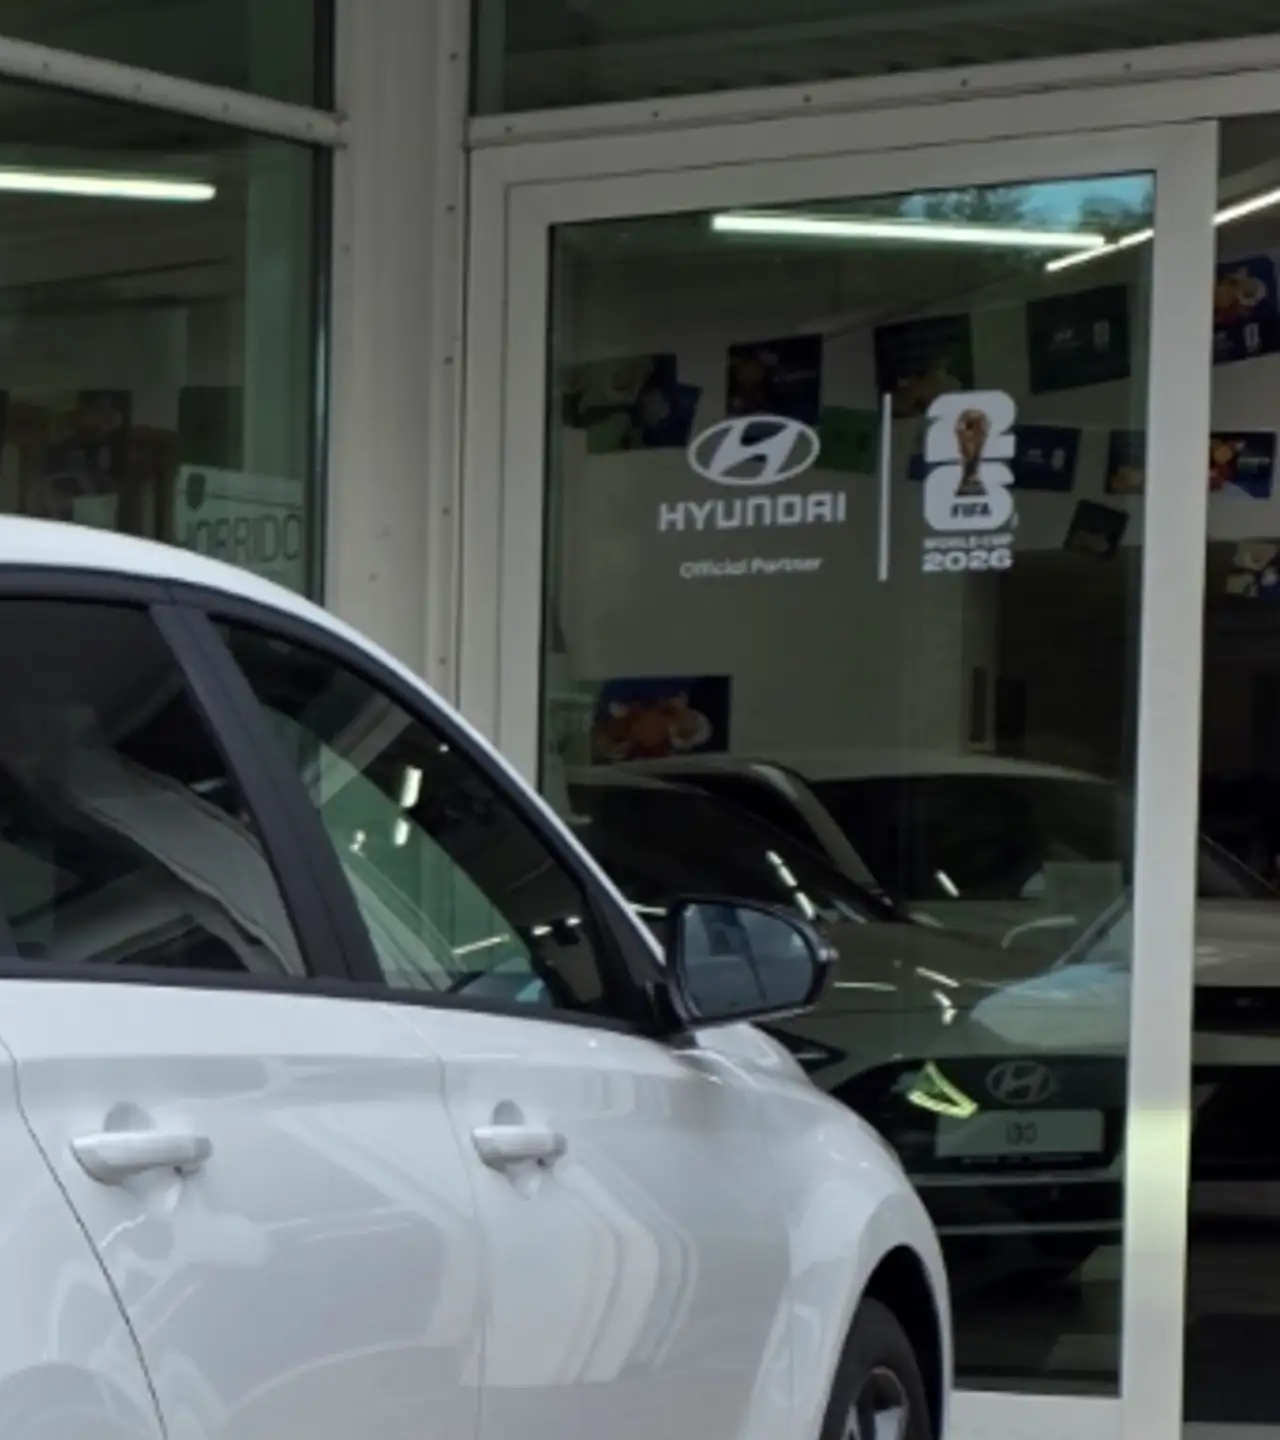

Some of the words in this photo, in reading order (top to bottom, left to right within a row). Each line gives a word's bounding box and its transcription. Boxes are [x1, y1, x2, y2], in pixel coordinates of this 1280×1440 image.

[658, 491, 847, 532] HYUNDAI
[949, 501, 993, 520] FIFA
[985, 534, 1015, 547] CUP
[679, 561, 746, 578] Official
[751, 556, 824, 575] Partner
[921, 549, 1014, 573] 2026
